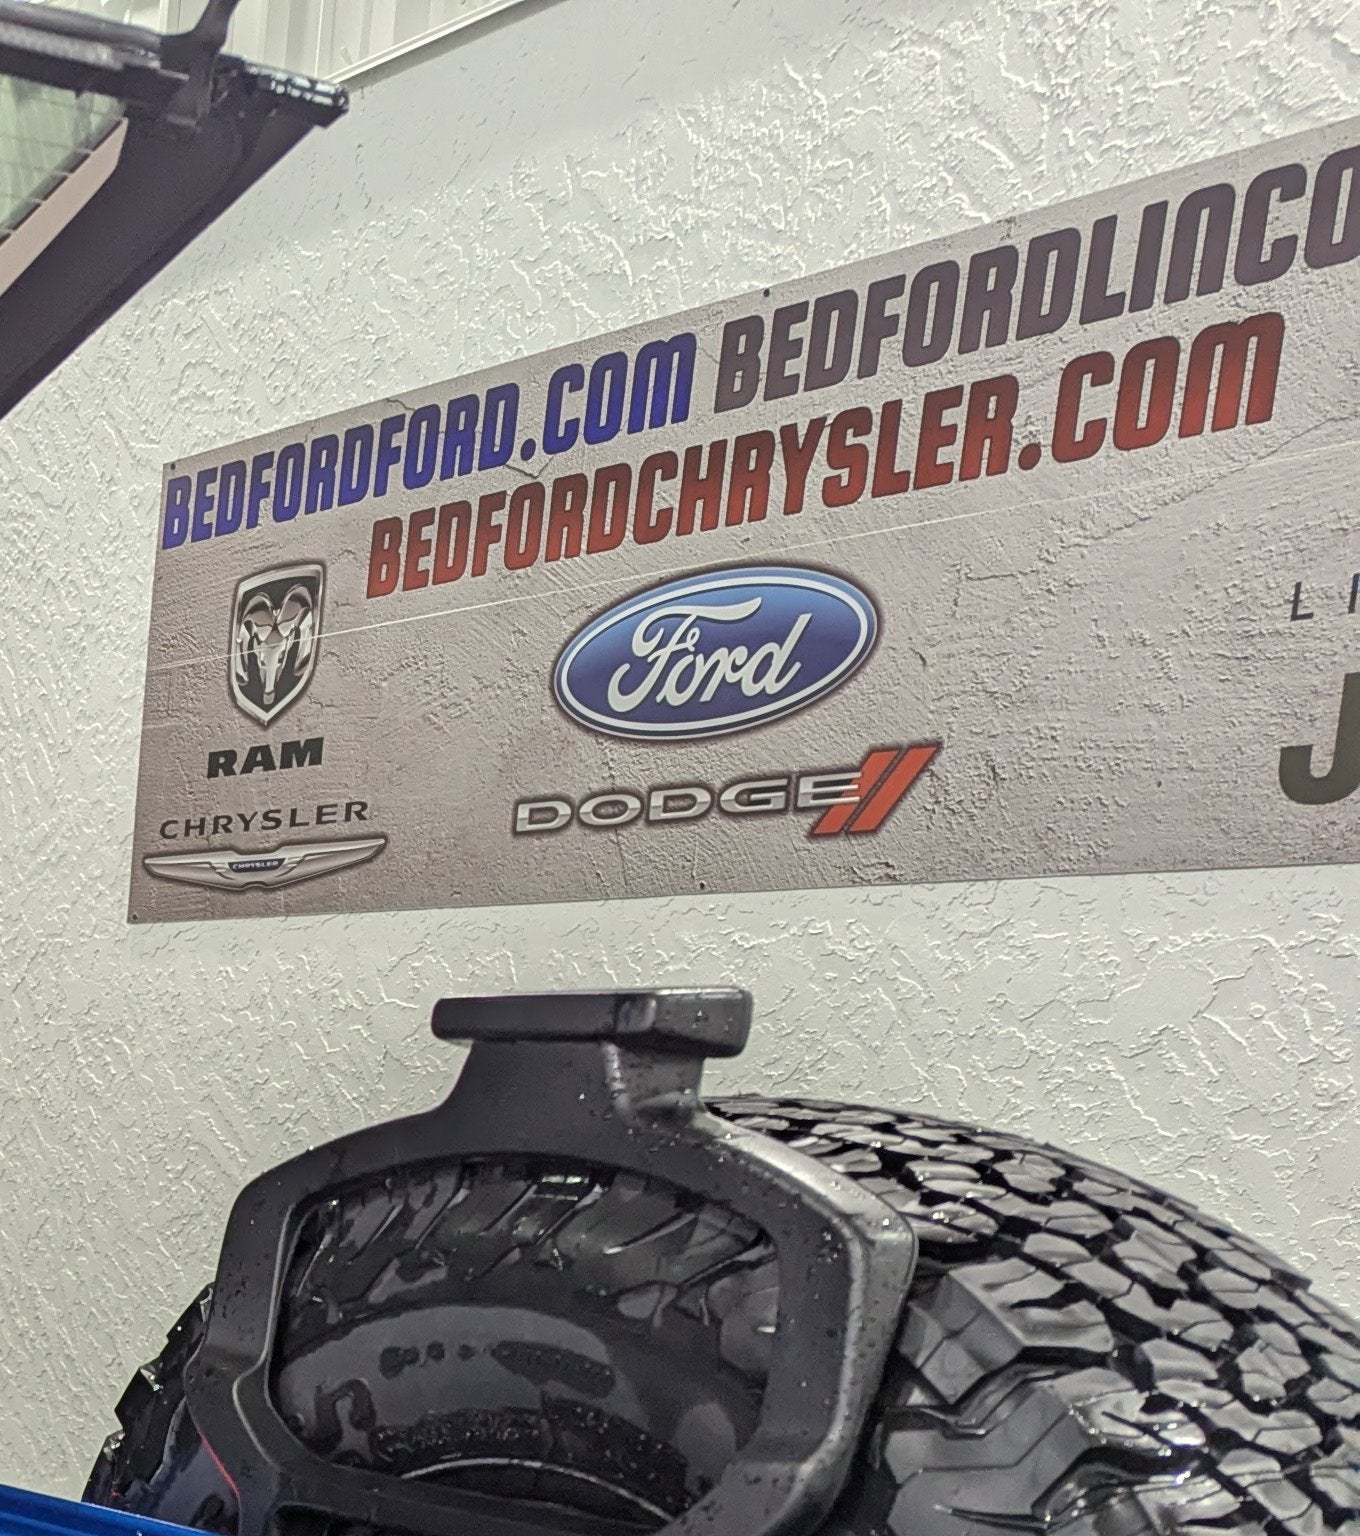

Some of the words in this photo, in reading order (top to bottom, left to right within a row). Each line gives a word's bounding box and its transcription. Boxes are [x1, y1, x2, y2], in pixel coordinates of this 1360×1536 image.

[161, 332, 697, 550] BEDFORDFORD.COM
[365, 311, 1285, 600] BEDFORDCHRYSLER.COM
[608, 597, 801, 712] Ford
[206, 736, 324, 779] RAM
[159, 800, 369, 840] CHRYSLER
[512, 772, 864, 835] DODGE
